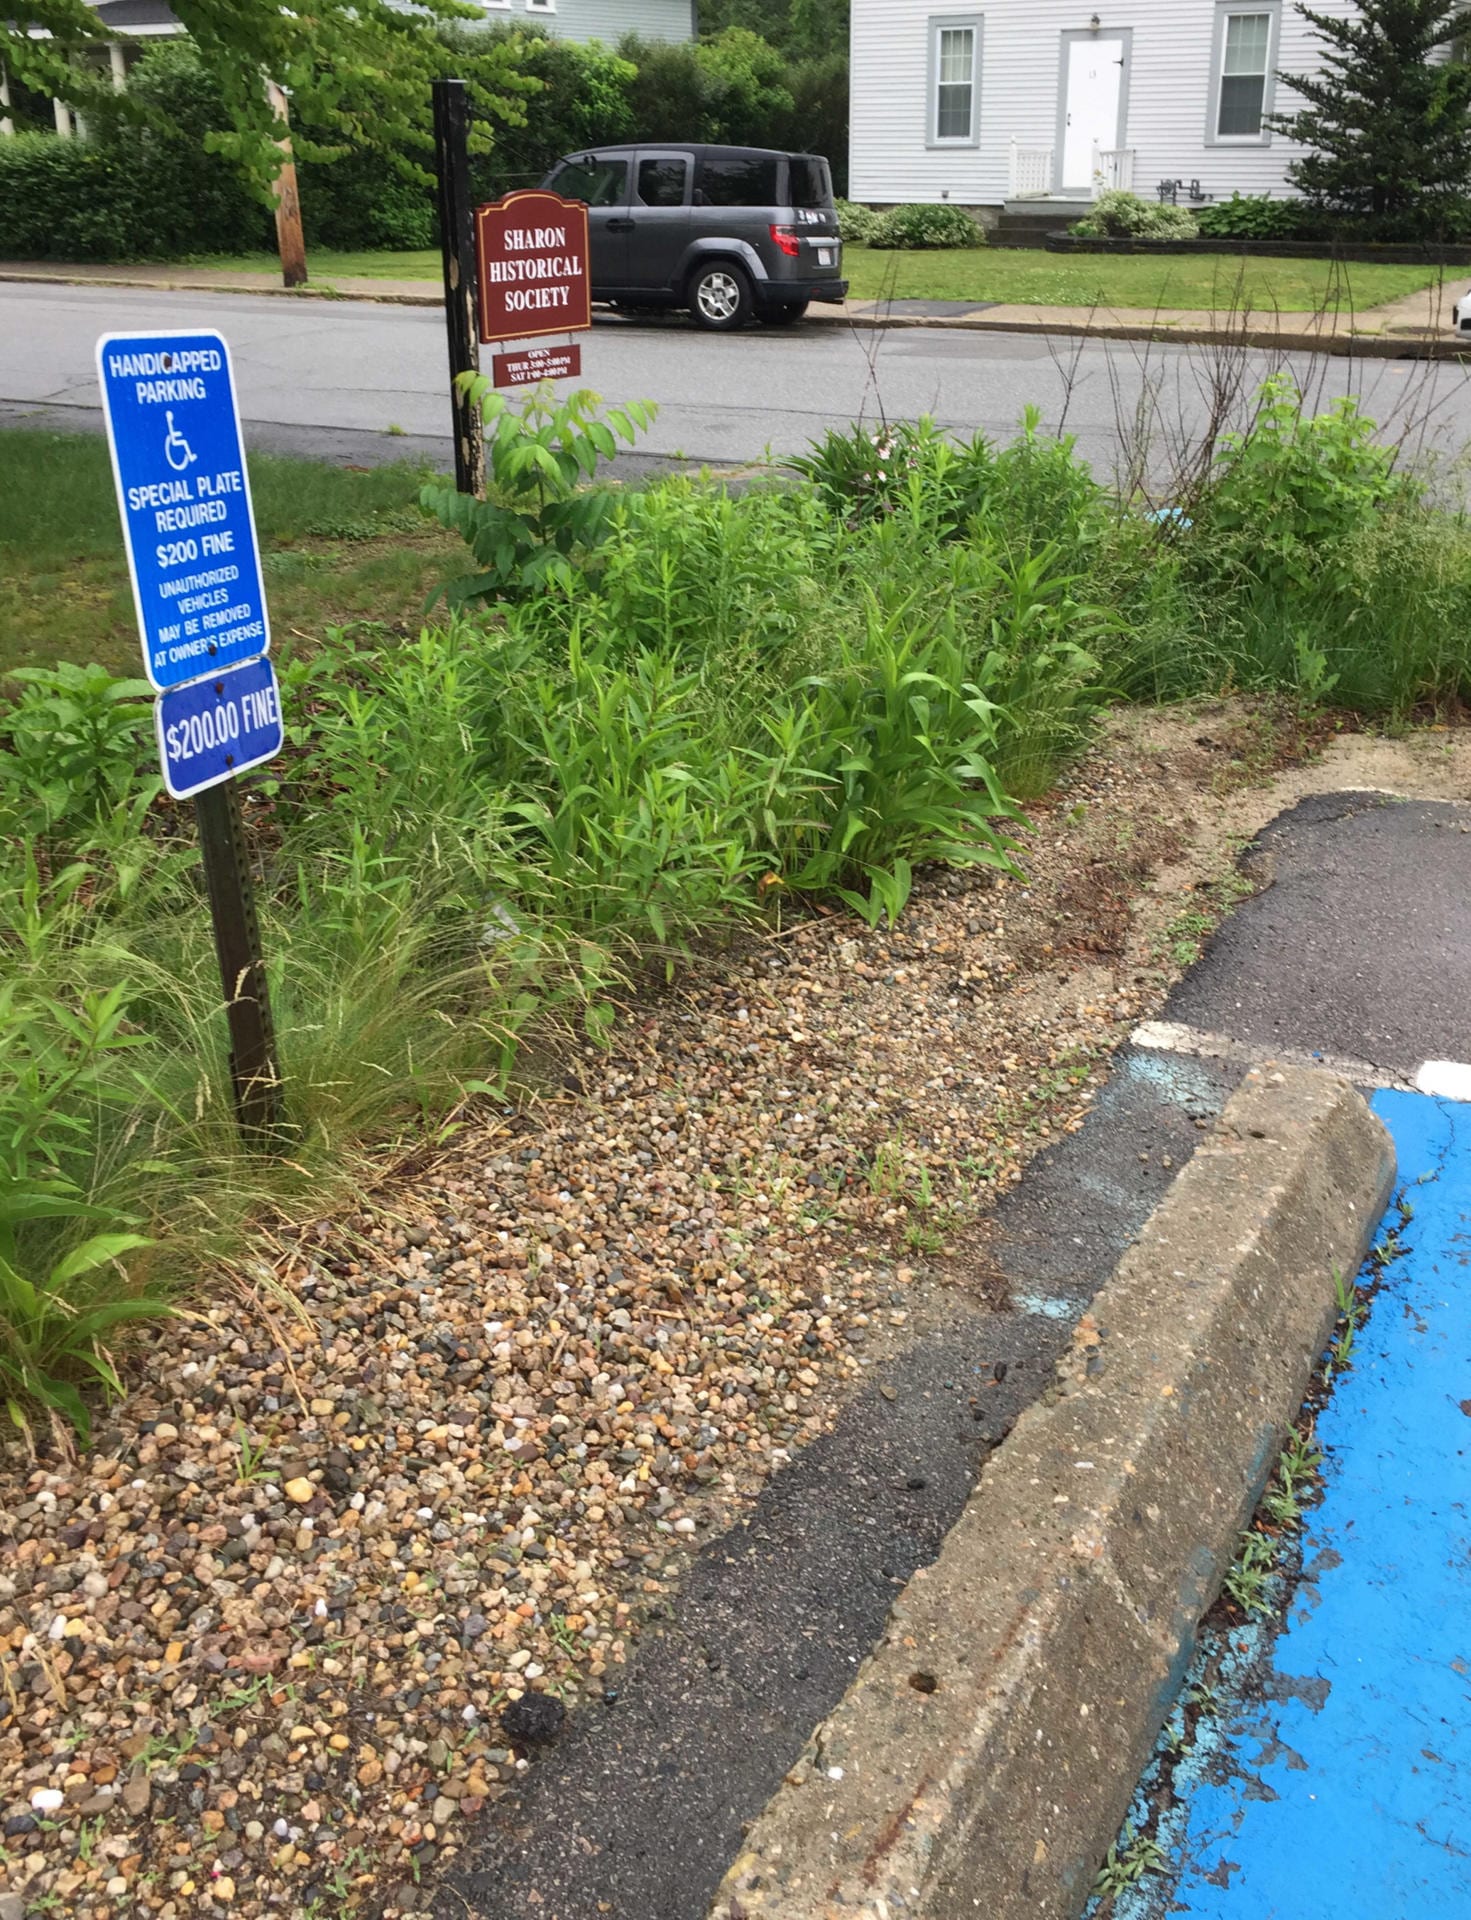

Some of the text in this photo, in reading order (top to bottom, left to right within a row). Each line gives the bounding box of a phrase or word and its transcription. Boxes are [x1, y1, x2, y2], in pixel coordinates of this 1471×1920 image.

[504, 227, 566, 251] SHARON
[489, 256, 582, 282] HISTORICAL
[505, 286, 570, 312] SOCIETY
[109, 350, 221, 378] HANDICAPPED
[506, 361, 529, 373] THUR
[527, 349, 551, 359] OPEN
[510, 371, 526, 382] SAT
[136, 378, 206, 404] PARKING
[128, 471, 242, 511] SPECIAL PLATE
[155, 500, 227, 533] REQUIRED
[156, 531, 235, 569] $200 FINE
[159, 565, 239, 599] UNAUTHORIZED
[177, 588, 229, 615] VEHICLES
[158, 603, 251, 644] MAY BE REMOVED
[154, 620, 264, 669] AT OWNER'S EXPENSE
[166, 686, 278, 763] $200.00 FINE
